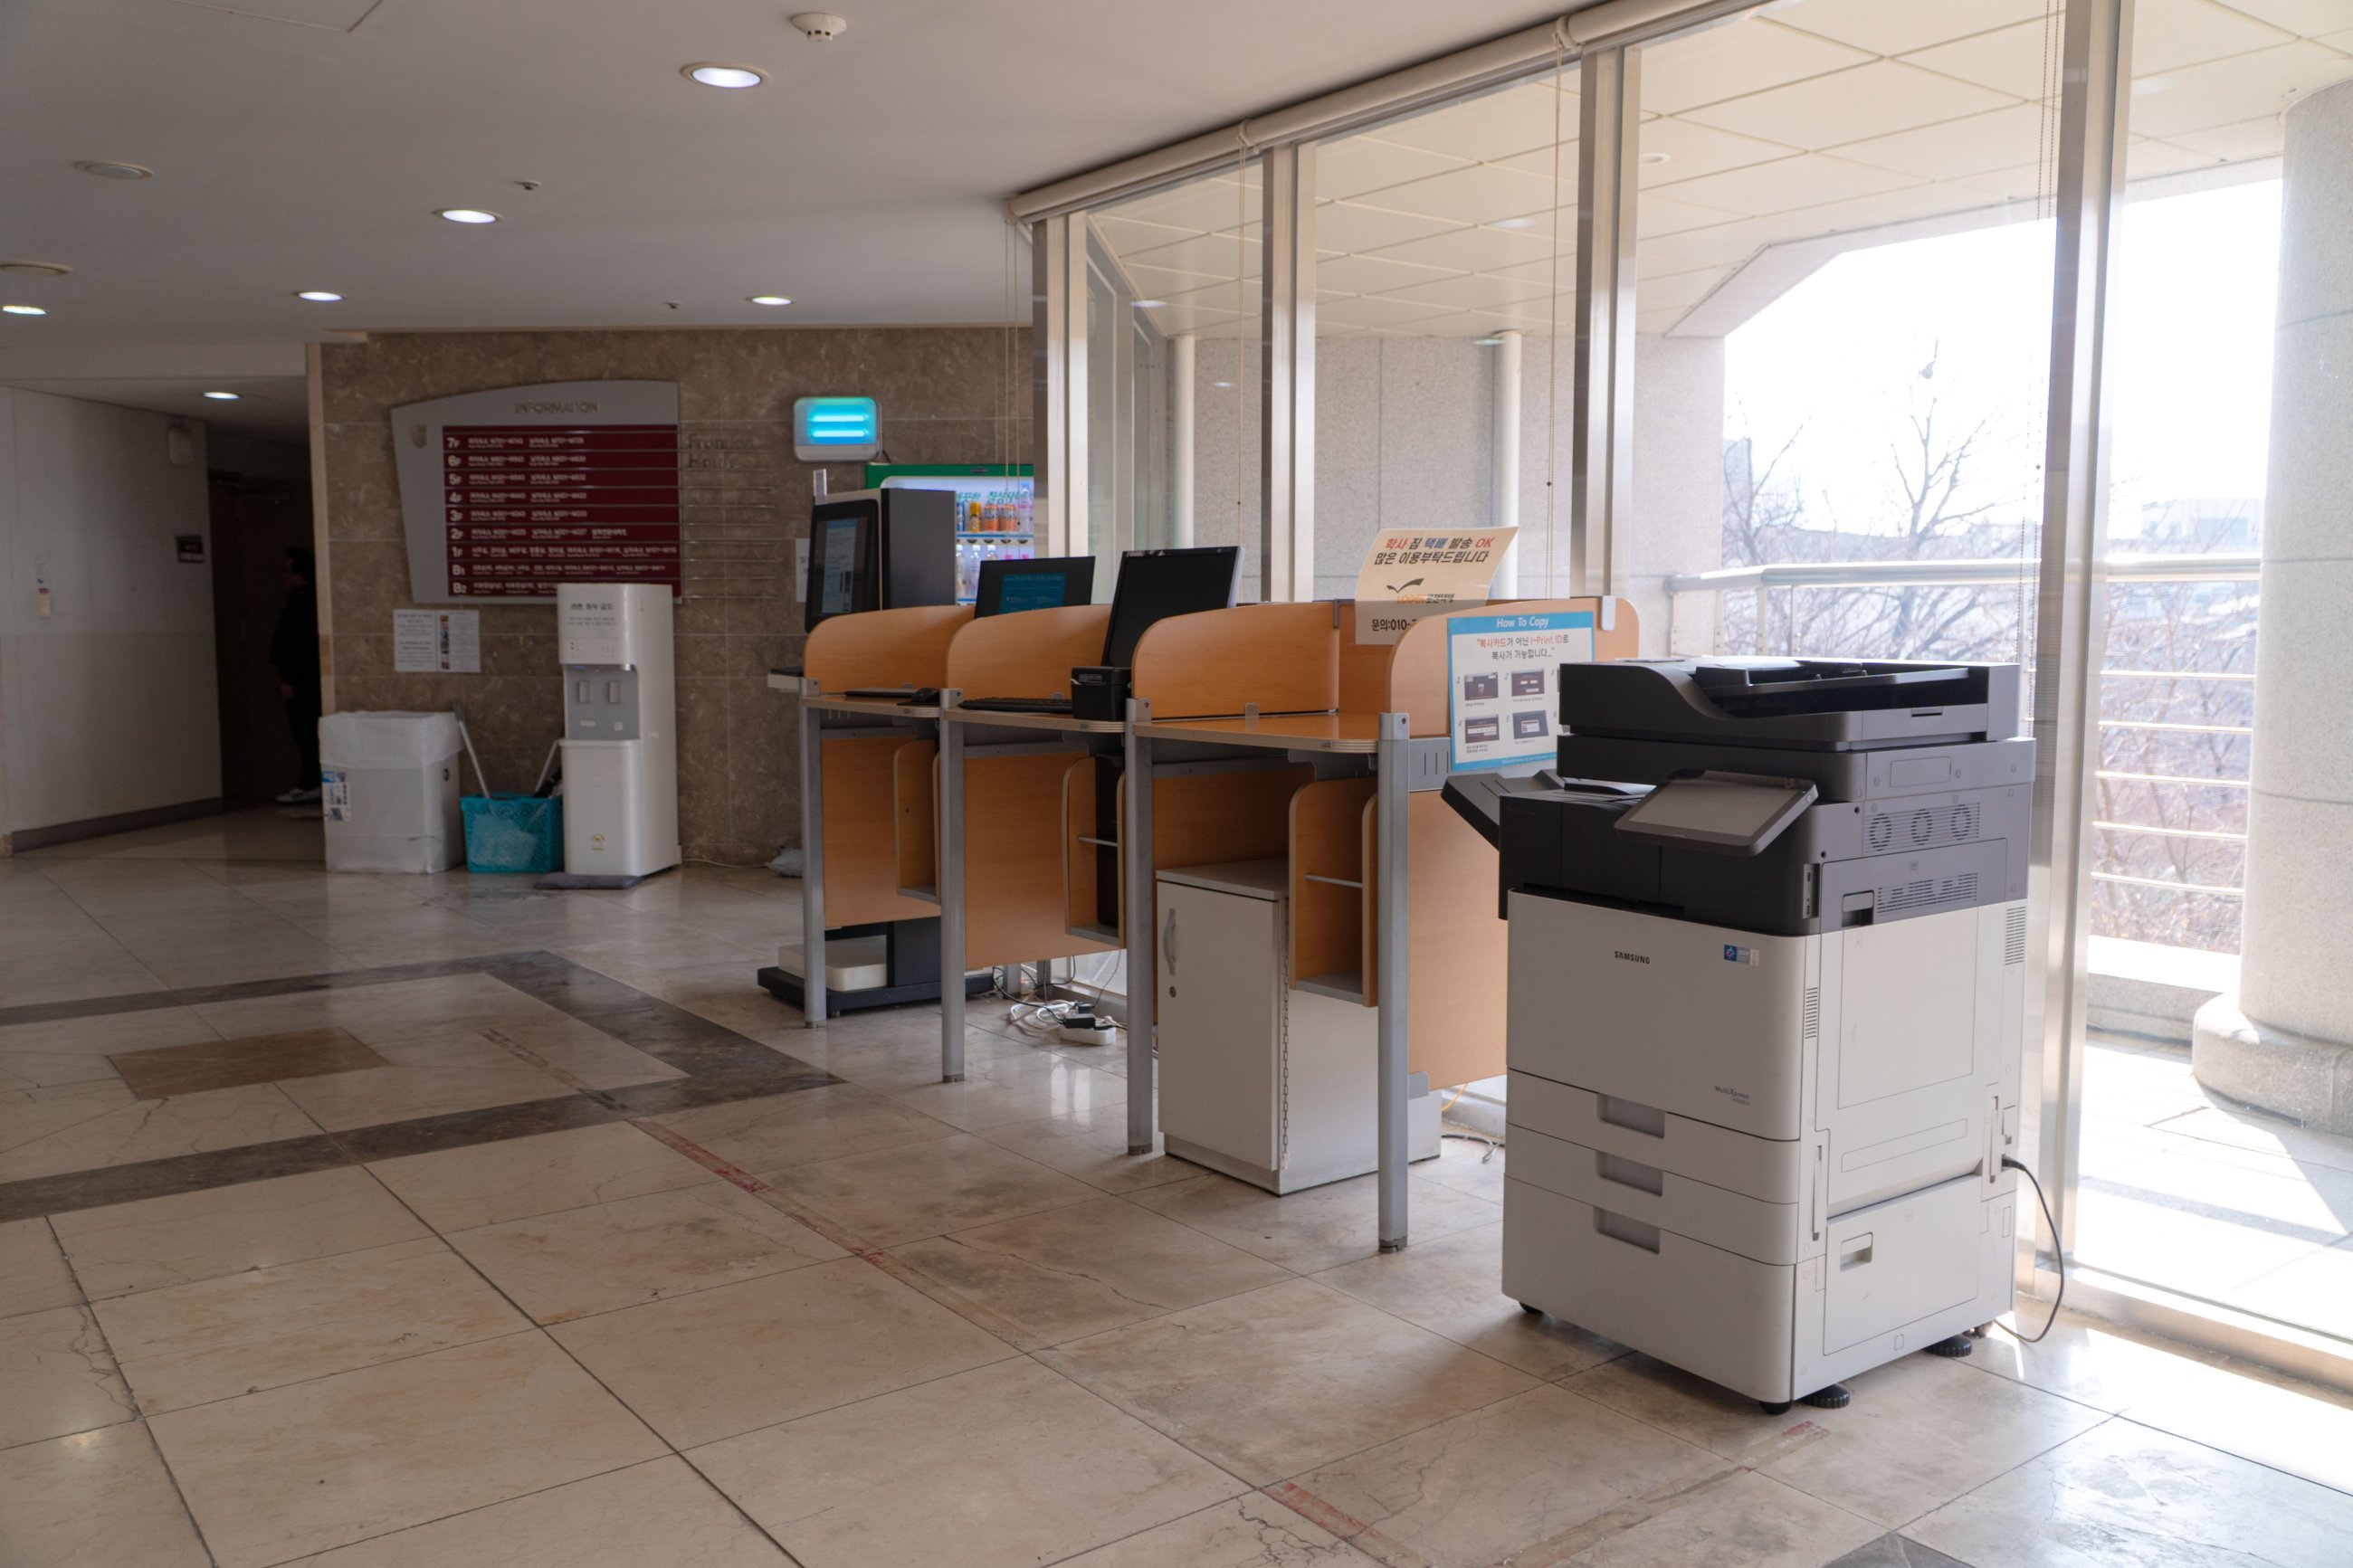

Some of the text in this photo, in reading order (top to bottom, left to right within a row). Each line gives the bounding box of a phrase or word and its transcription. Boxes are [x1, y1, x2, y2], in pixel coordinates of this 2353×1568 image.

[515, 402, 598, 414] INFORMATION
[447, 454, 462, 468] 6F
[451, 527, 463, 540] 2F
[1385, 537, 1495, 551] 학사 짐 택배 발송 OK
[1374, 549, 1490, 565] 많은 이용부탁드립니다
[1371, 618, 1418, 632] 문의:010-
[1496, 615, 1549, 629] How To Copy
[1516, 637, 1529, 647] 아닌
[1491, 651, 1513, 661] 복사가
[1615, 950, 1650, 965] SAMSUNG
